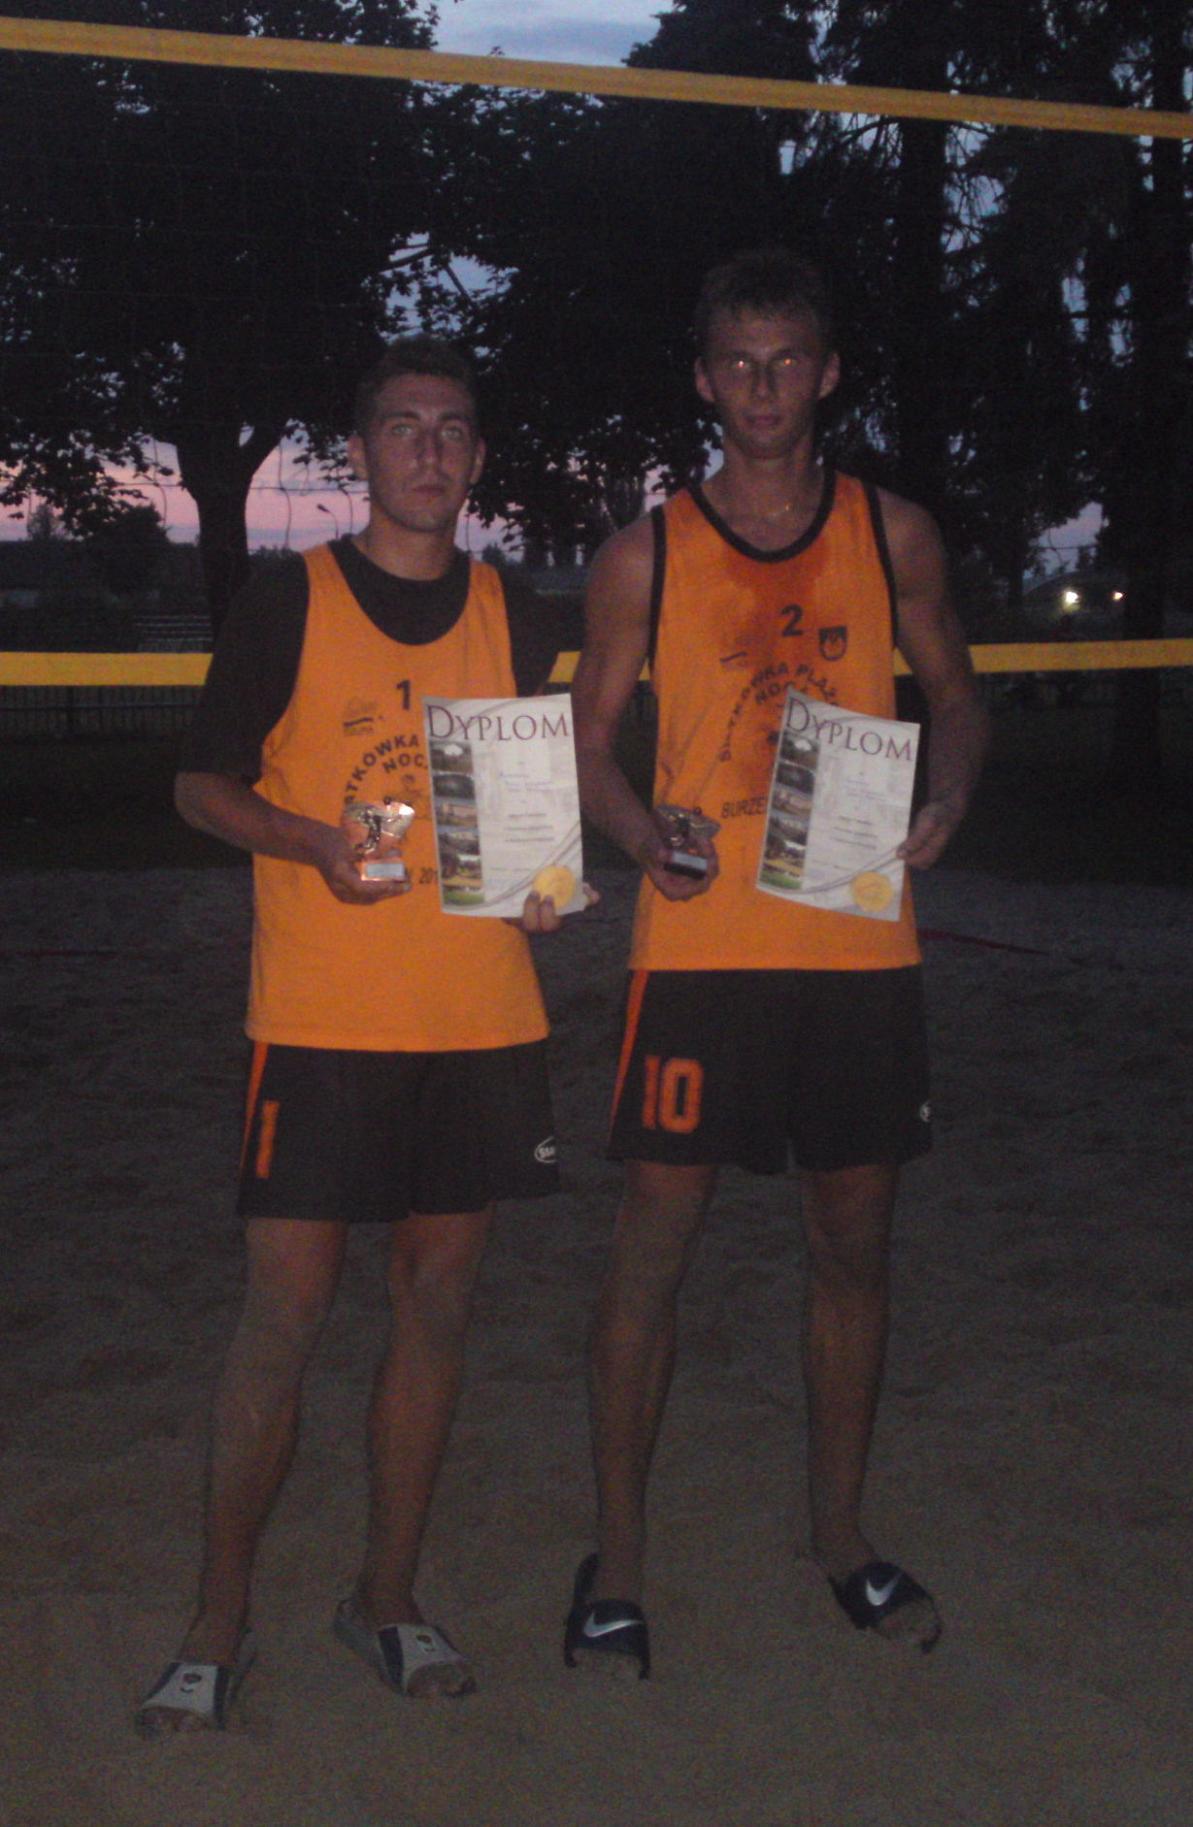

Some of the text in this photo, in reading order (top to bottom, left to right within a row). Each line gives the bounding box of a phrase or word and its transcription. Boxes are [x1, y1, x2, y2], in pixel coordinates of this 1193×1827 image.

[781, 604, 804, 637] 2
[396, 679, 411, 711] 1
[427, 704, 569, 741] DYPLOM
[786, 696, 912, 762] DYPLOM
[383, 753, 429, 774] NOC
[641, 1055, 704, 1135] 10
[255, 1099, 281, 1179] 1
